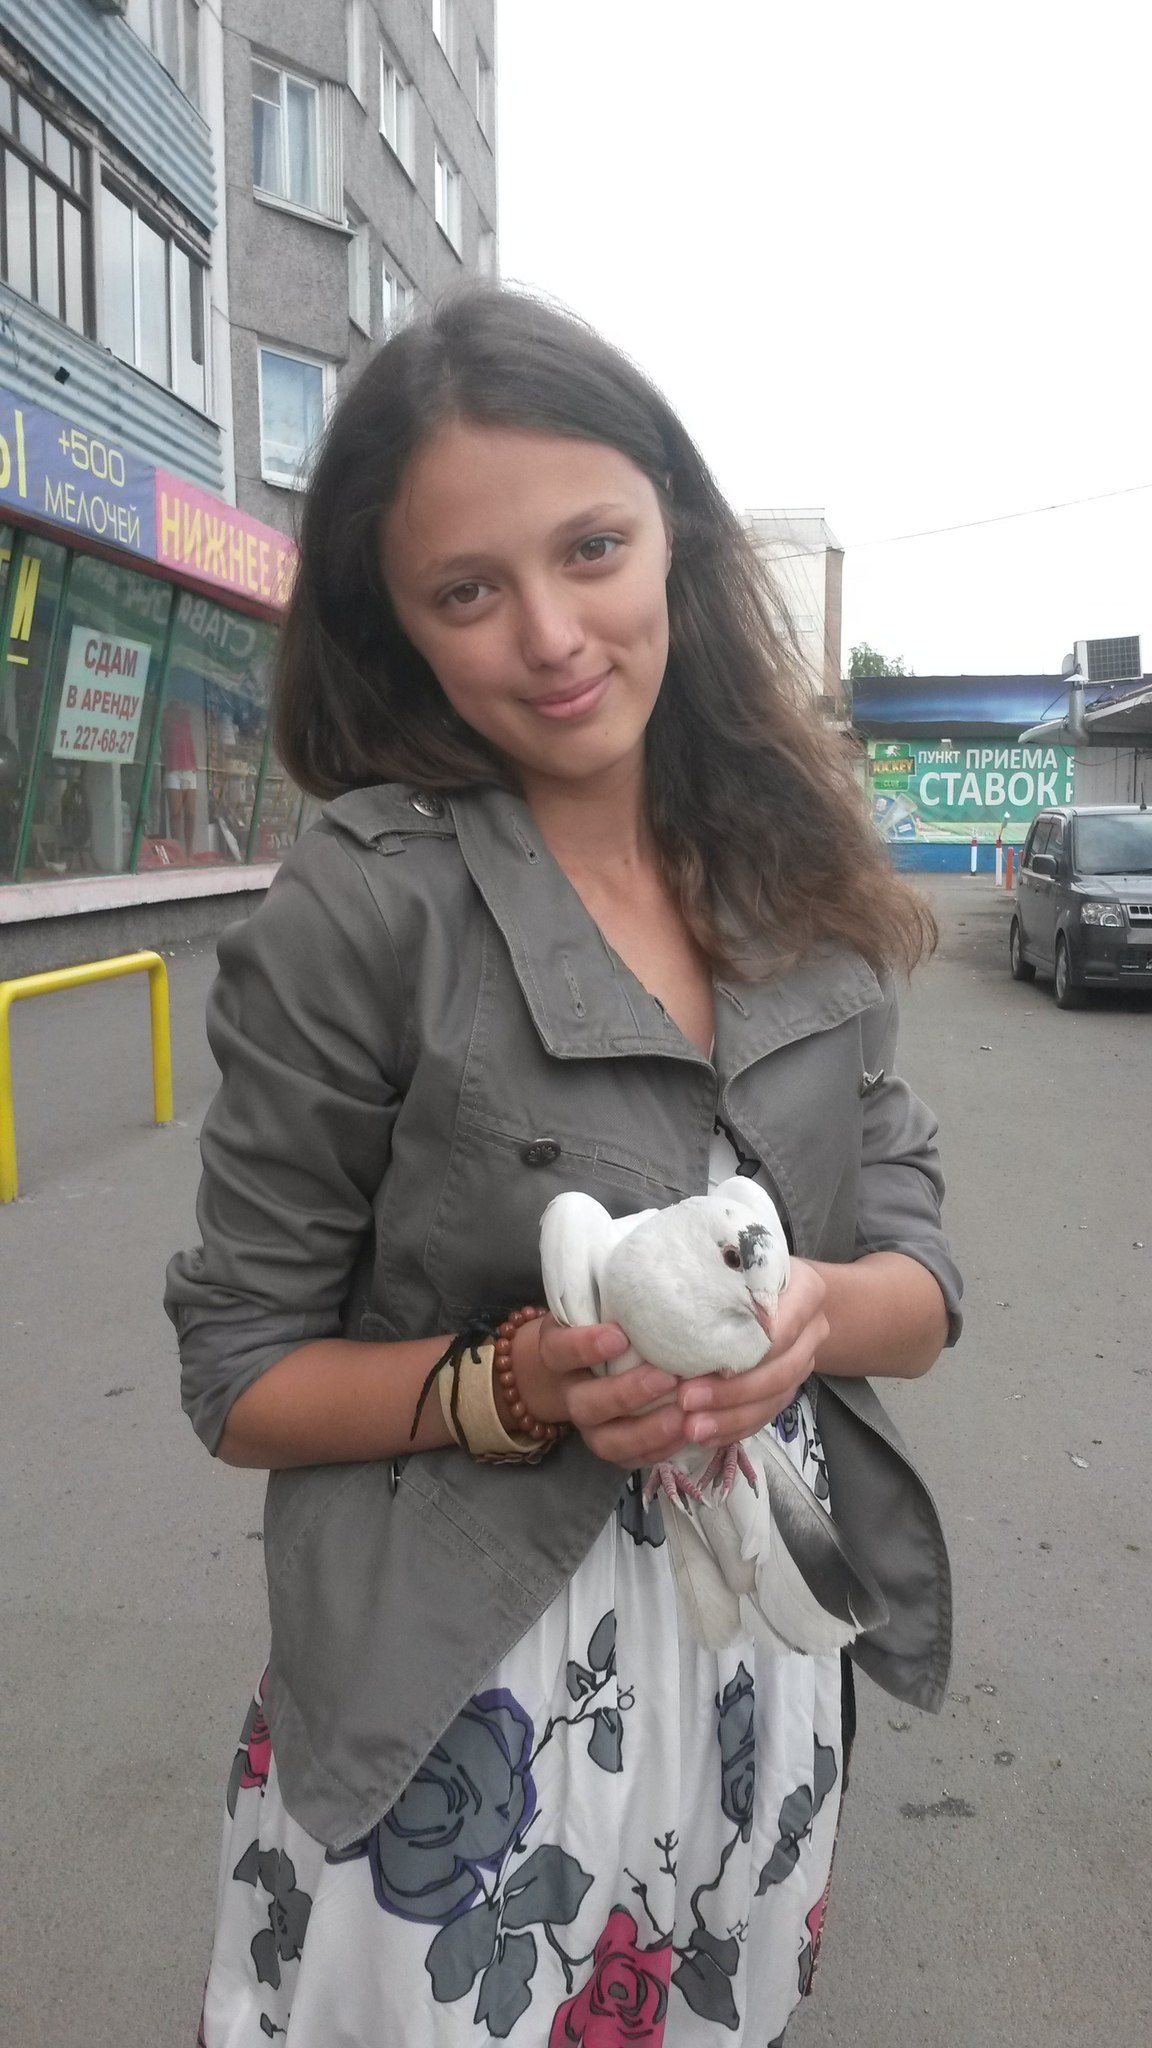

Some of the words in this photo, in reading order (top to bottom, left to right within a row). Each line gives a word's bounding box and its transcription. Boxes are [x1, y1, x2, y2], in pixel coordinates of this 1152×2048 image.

[58, 428, 125, 487] +500
[45, 475, 141, 548] МЕЛОЧЕЙ
[161, 492, 272, 597] НИЖНЕЕ
[84, 639, 139, 678] СДАМ
[66, 685, 78, 708] В
[81, 688, 139, 721] АРЕНДУ
[918, 751, 961, 764] ПУНКТ
[966, 748, 1058, 769] ПРИЕМА
[919, 771, 1059, 806] СТАВОК
